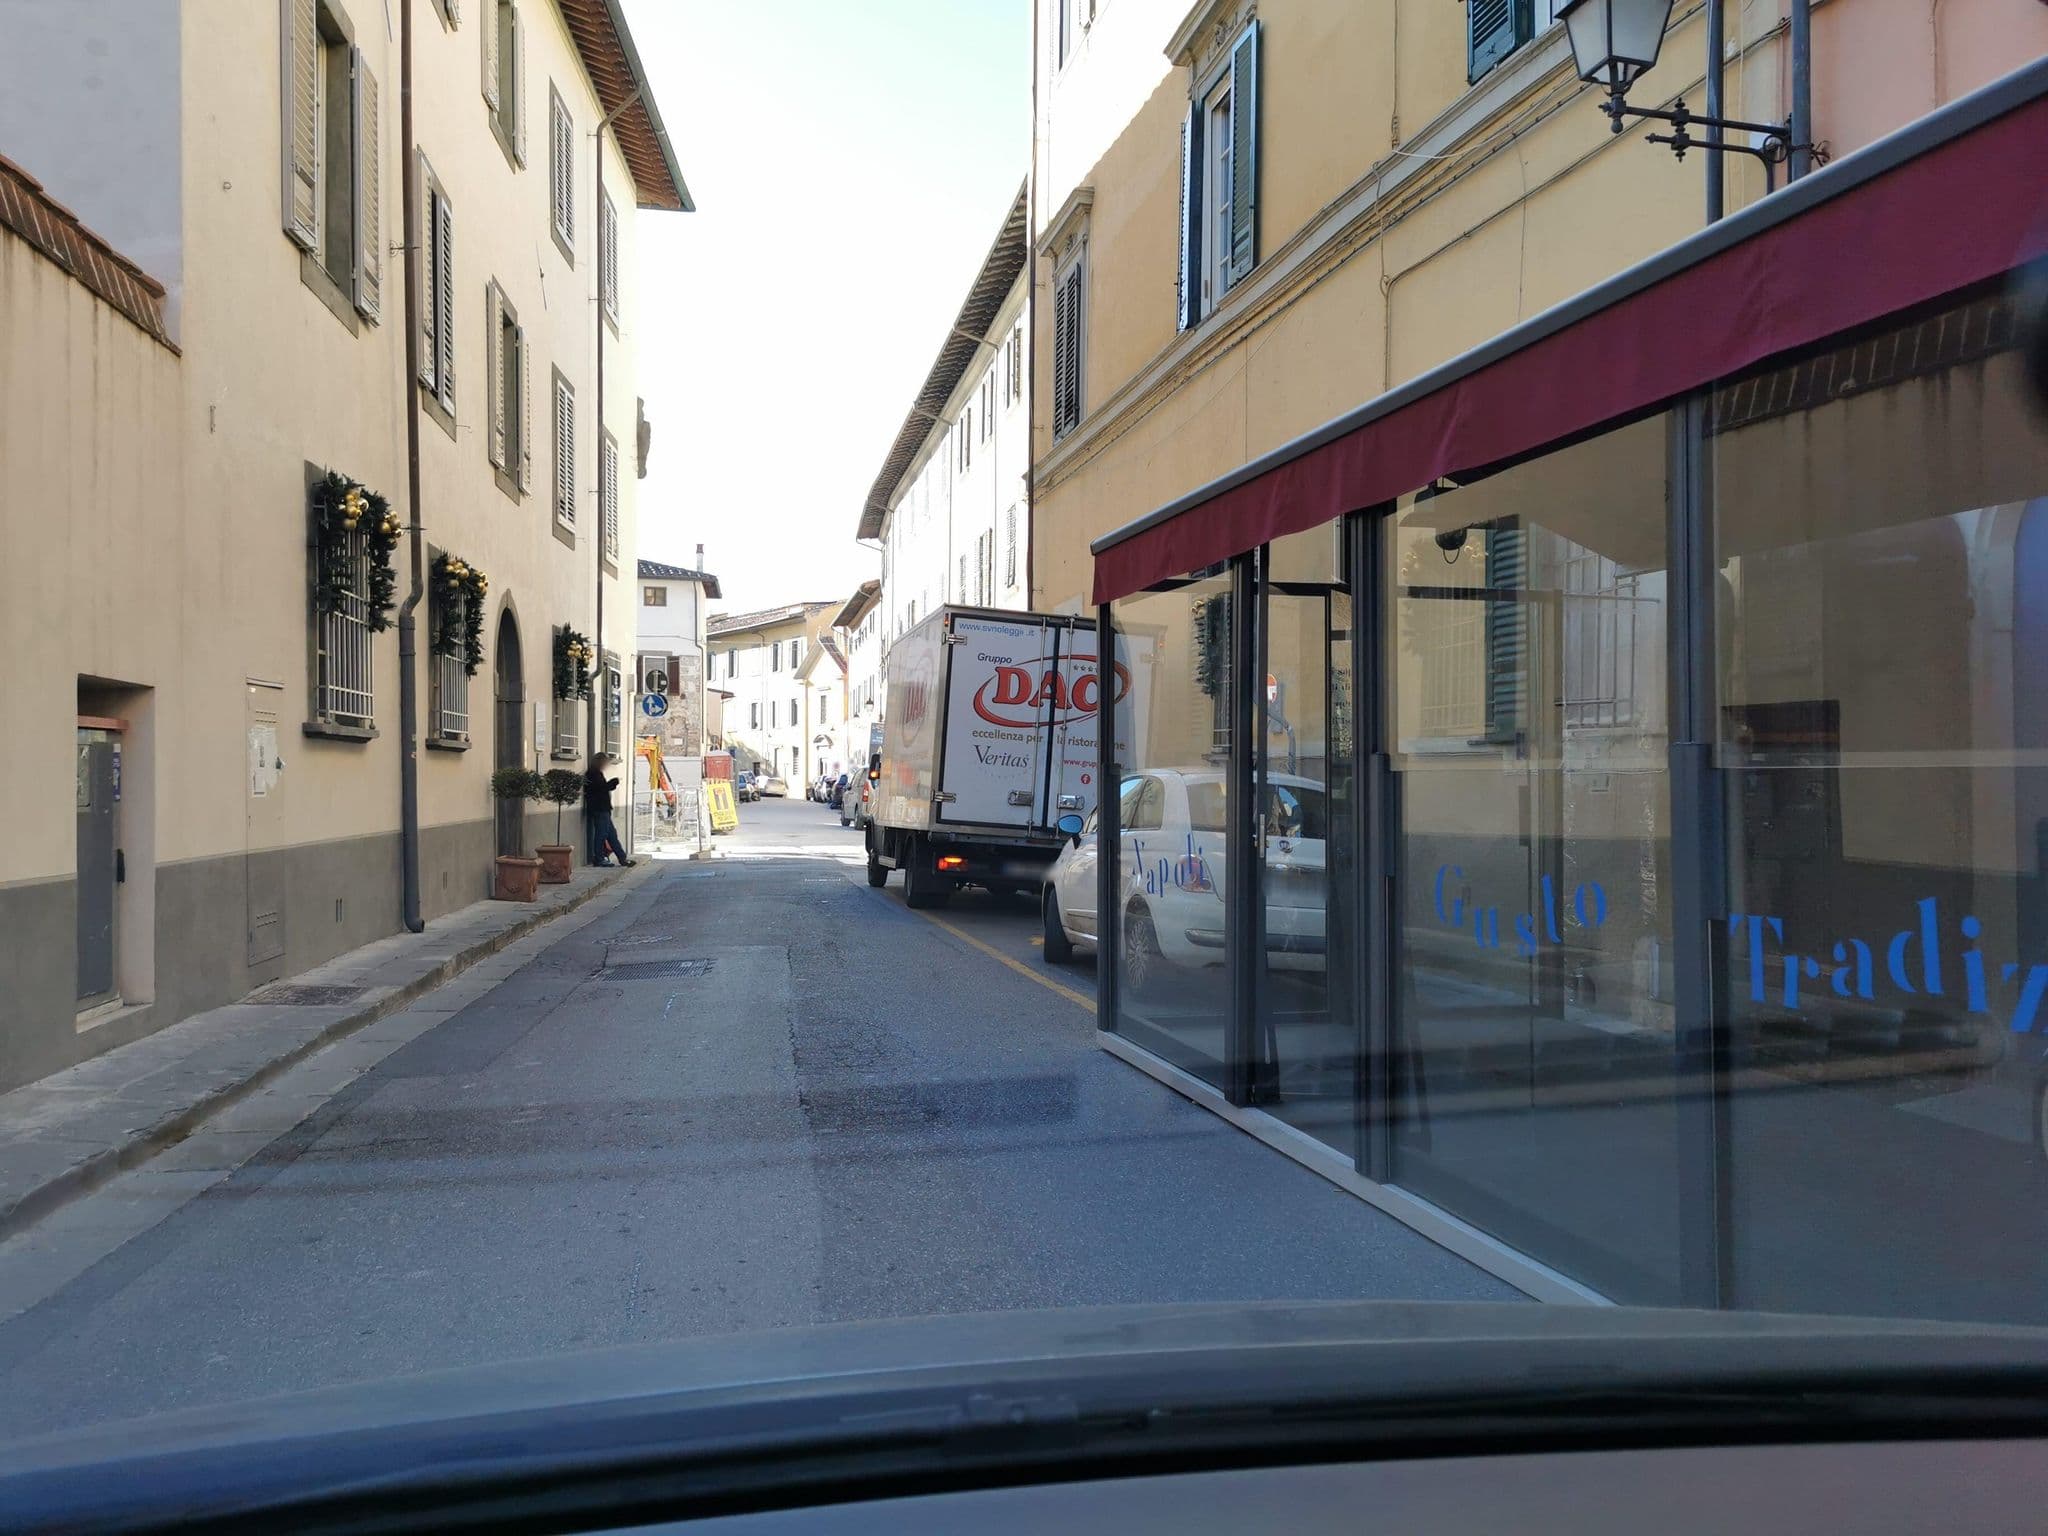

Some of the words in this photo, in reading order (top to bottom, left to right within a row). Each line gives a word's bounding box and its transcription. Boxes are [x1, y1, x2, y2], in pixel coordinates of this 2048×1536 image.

[977, 652, 1013, 665] Gruppo
[972, 729, 1023, 742] eccellenza
[1026, 734, 1044, 744] per
[973, 744, 1030, 768] Veritas
[1434, 864, 1608, 957] Gusto
